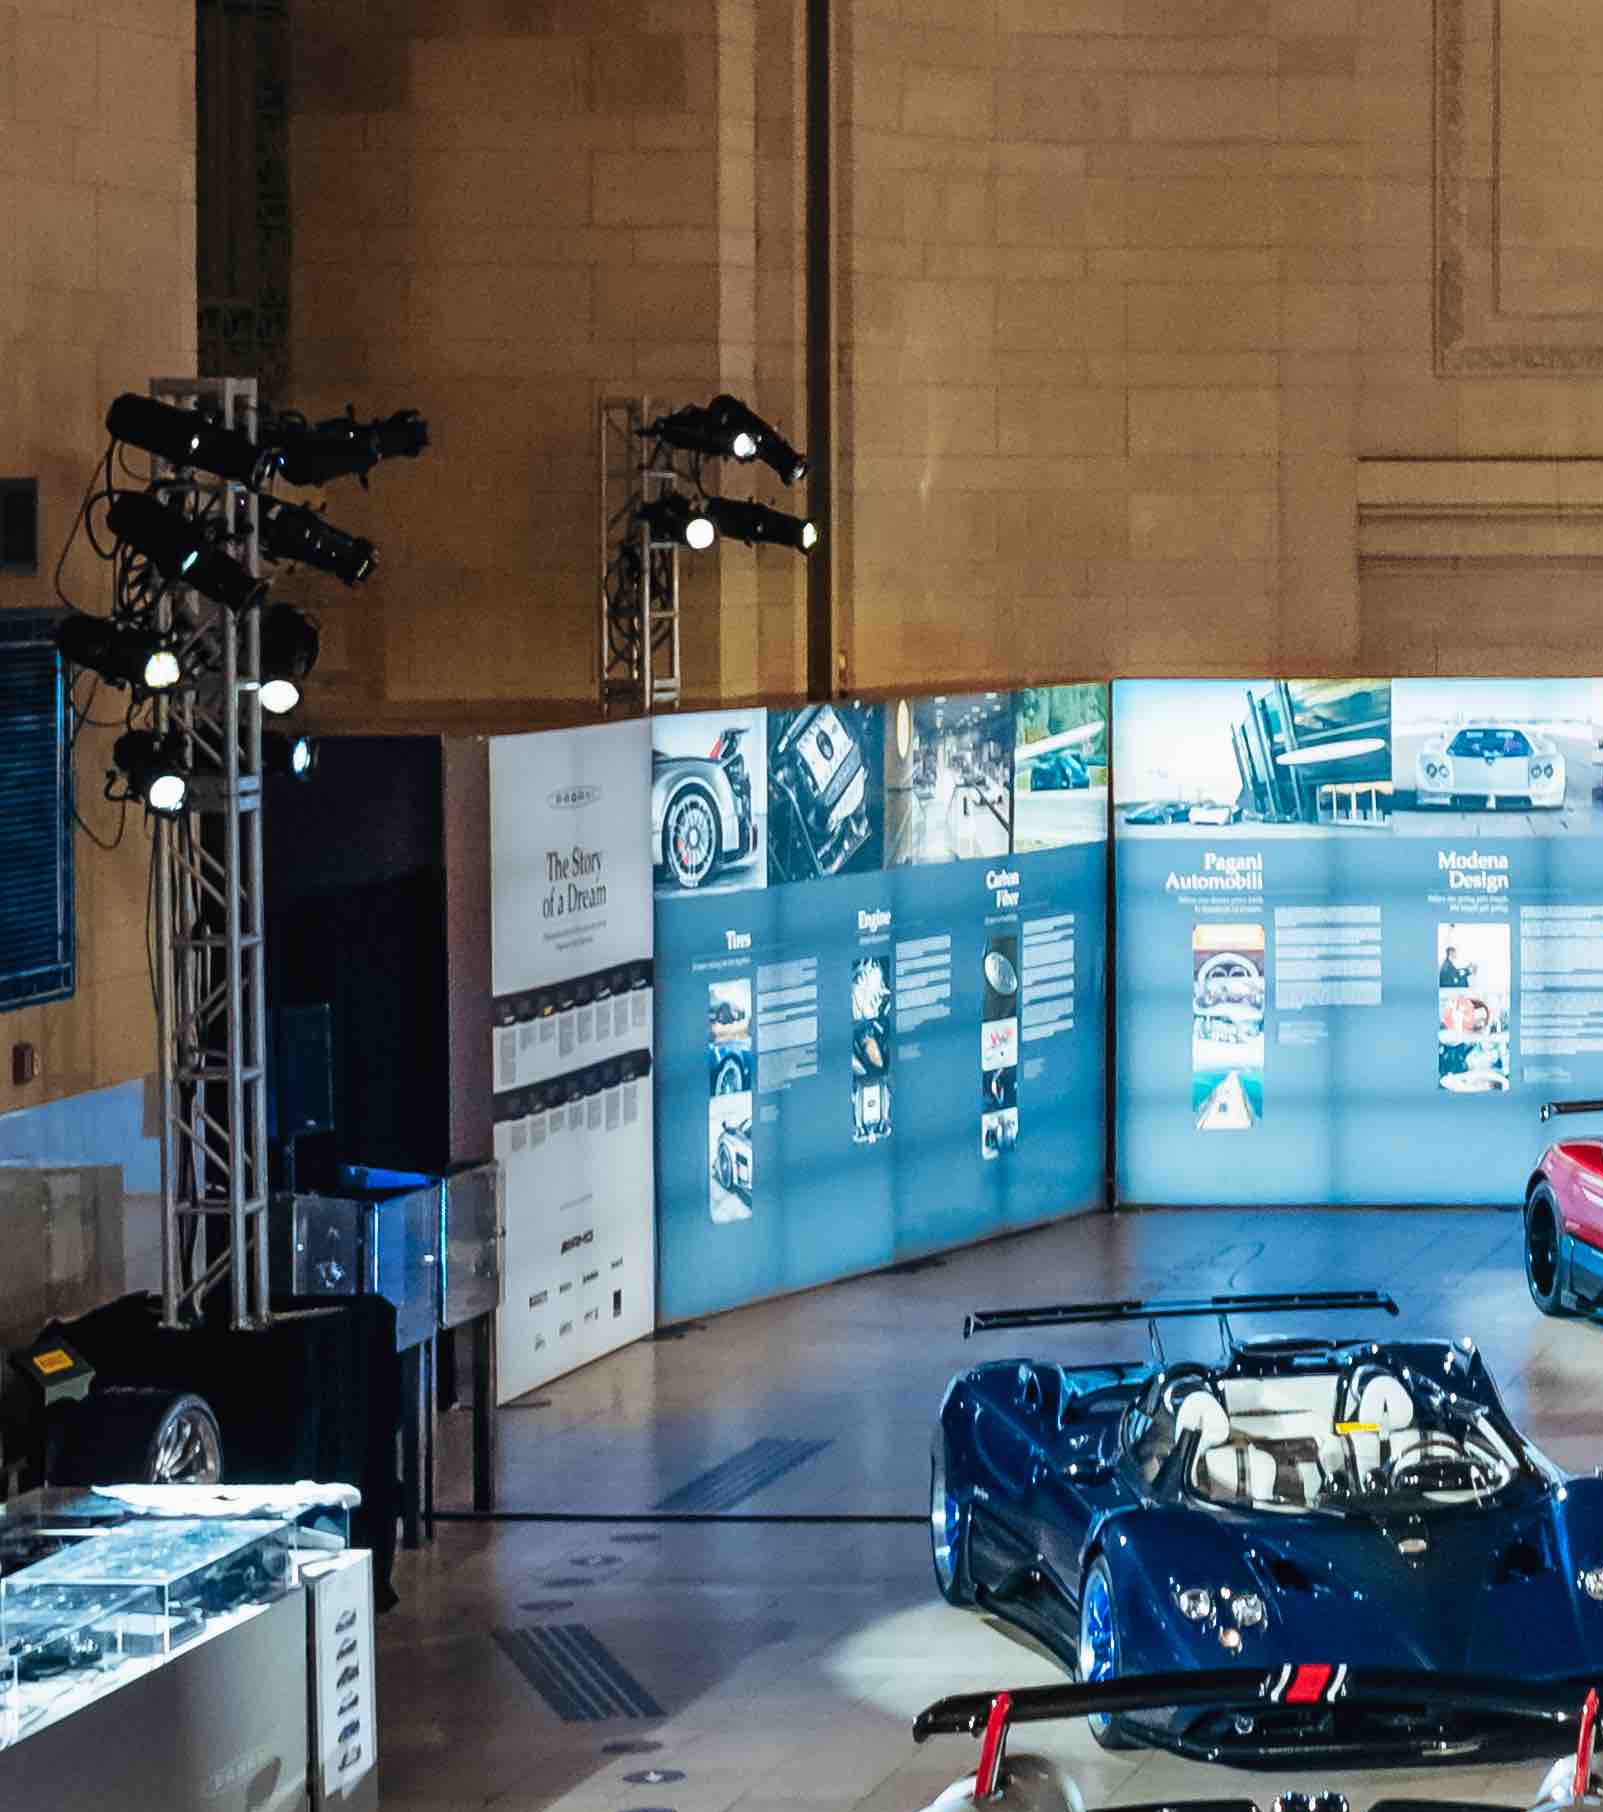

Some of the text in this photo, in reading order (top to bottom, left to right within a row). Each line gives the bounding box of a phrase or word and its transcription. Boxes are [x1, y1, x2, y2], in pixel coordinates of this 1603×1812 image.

[545, 845, 603, 884] The Story
[1204, 851, 1263, 873] Pagani
[1438, 850, 1509, 869] Modena
[984, 870, 1020, 890] Carbon
[1165, 872, 1263, 890] Automobili
[1448, 870, 1509, 893] Design
[542, 882, 607, 919] of a Dream
[856, 909, 892, 932] Engine
